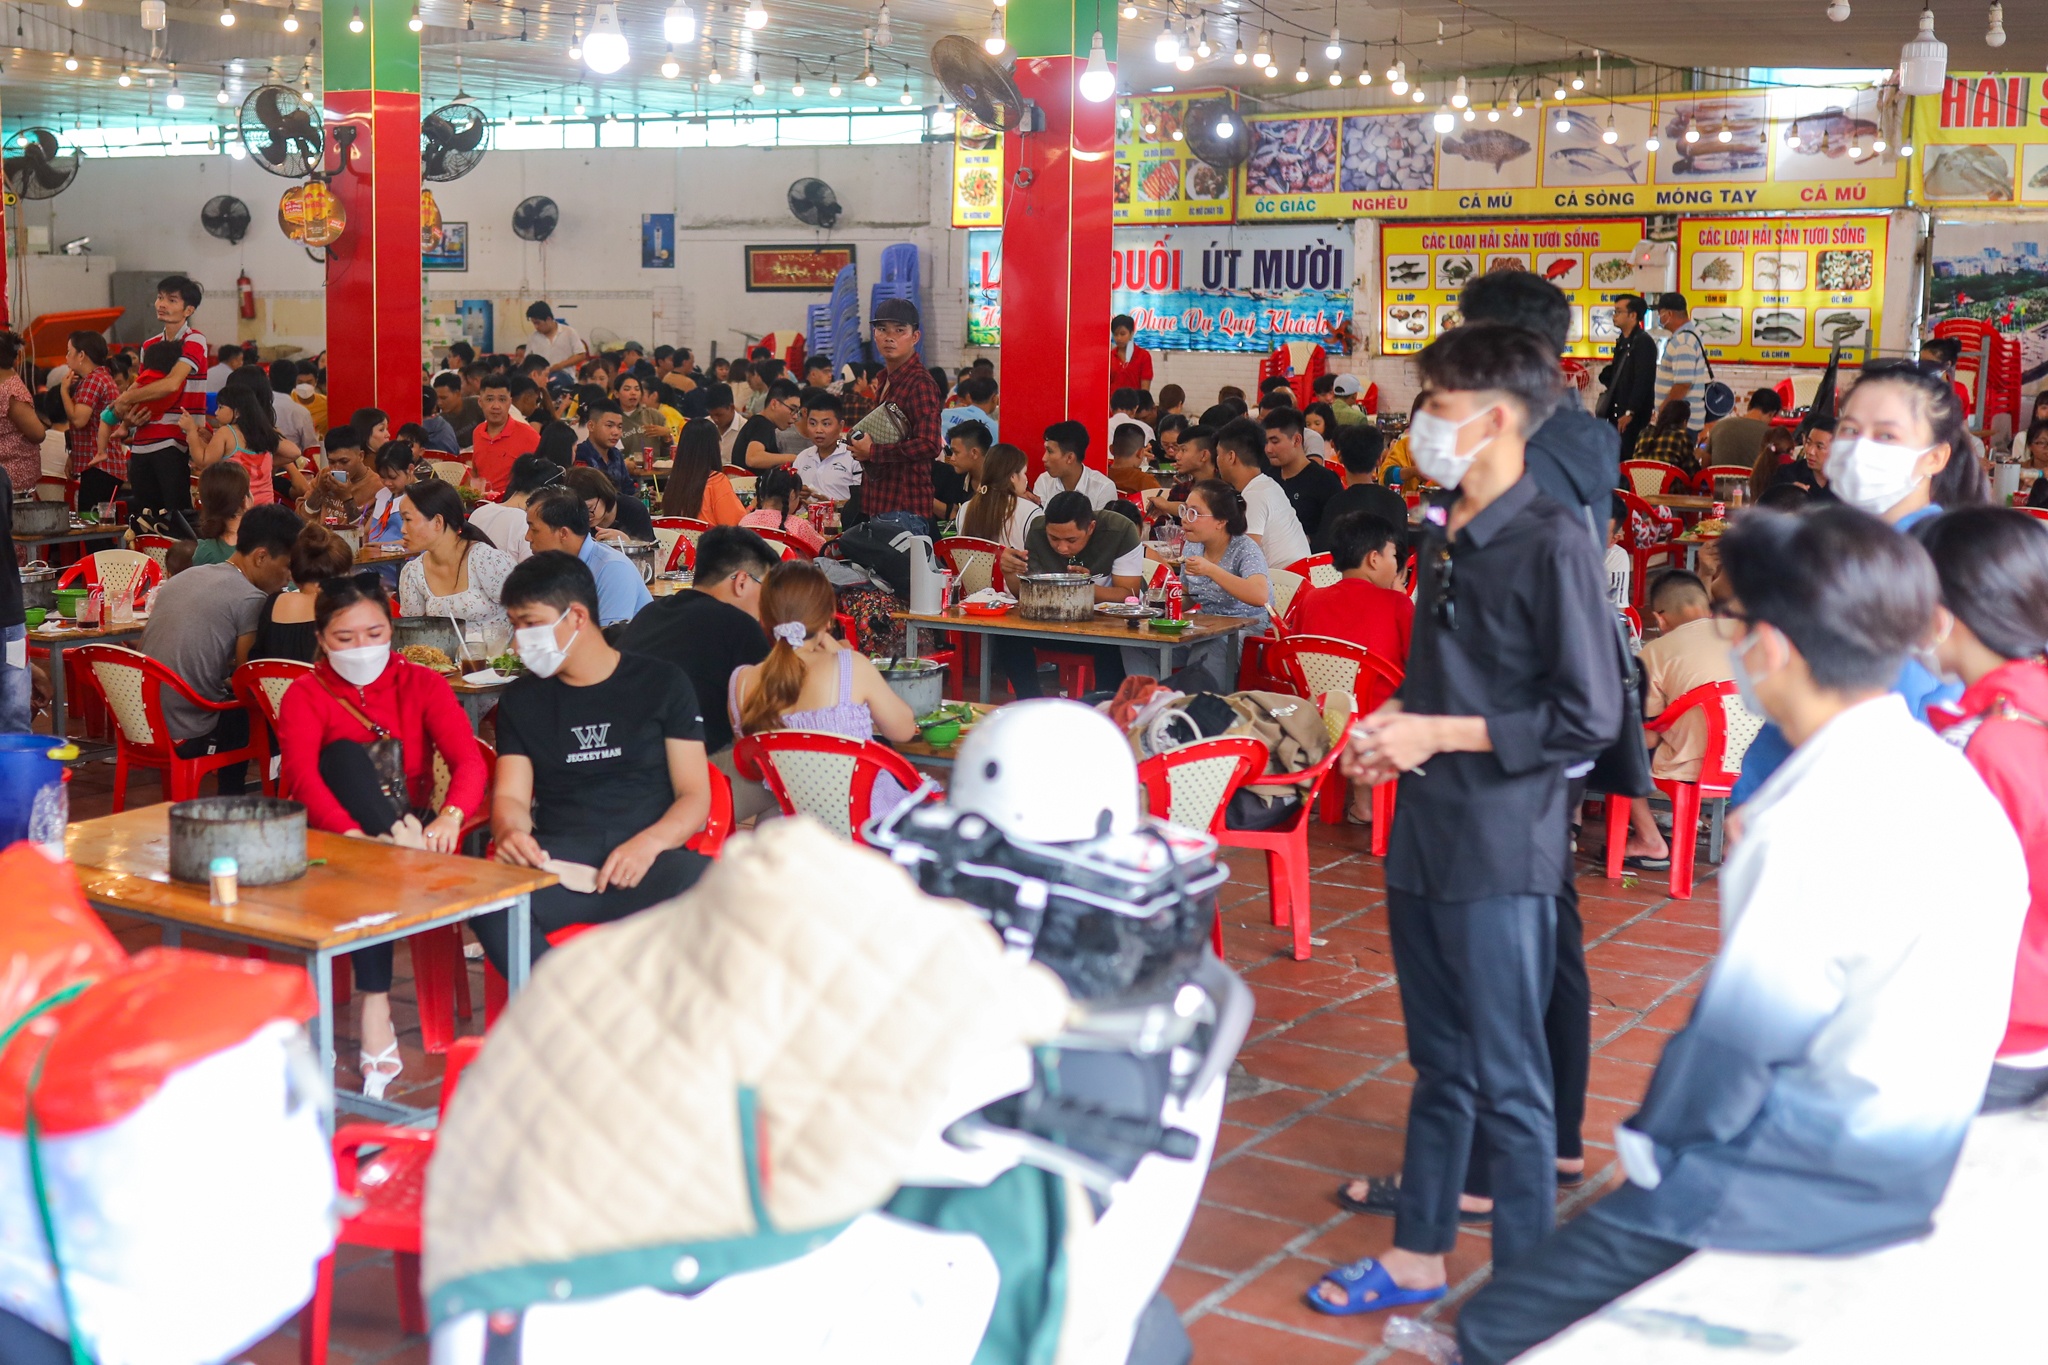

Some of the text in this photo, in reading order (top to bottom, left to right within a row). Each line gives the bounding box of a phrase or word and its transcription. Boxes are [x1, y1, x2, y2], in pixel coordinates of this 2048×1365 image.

[1459, 190, 1513, 209] CÁ MÚ
[1554, 189, 1635, 208] CÁ SÒNG
[1656, 188, 1758, 205] MÓNG TAY
[1800, 182, 1866, 202] CÁ MÚ
[1254, 196, 1317, 213] ỐC GIÁC
[1352, 194, 1408, 210] NGHÊU
[1422, 226, 1600, 254] CÁC LOẠI HẢI SẢN TƯƠI SỐNG
[1698, 222, 1866, 250] CÁC LOẠI HẢI SẢN TƯƠI SỐNG
[1202, 240, 1242, 290] ÚT
[1253, 238, 1342, 290] MƯỜI
[1219, 308, 1256, 338] Quý
[570, 723, 611, 750] W
[566, 747, 622, 763] JECKEY MAN
